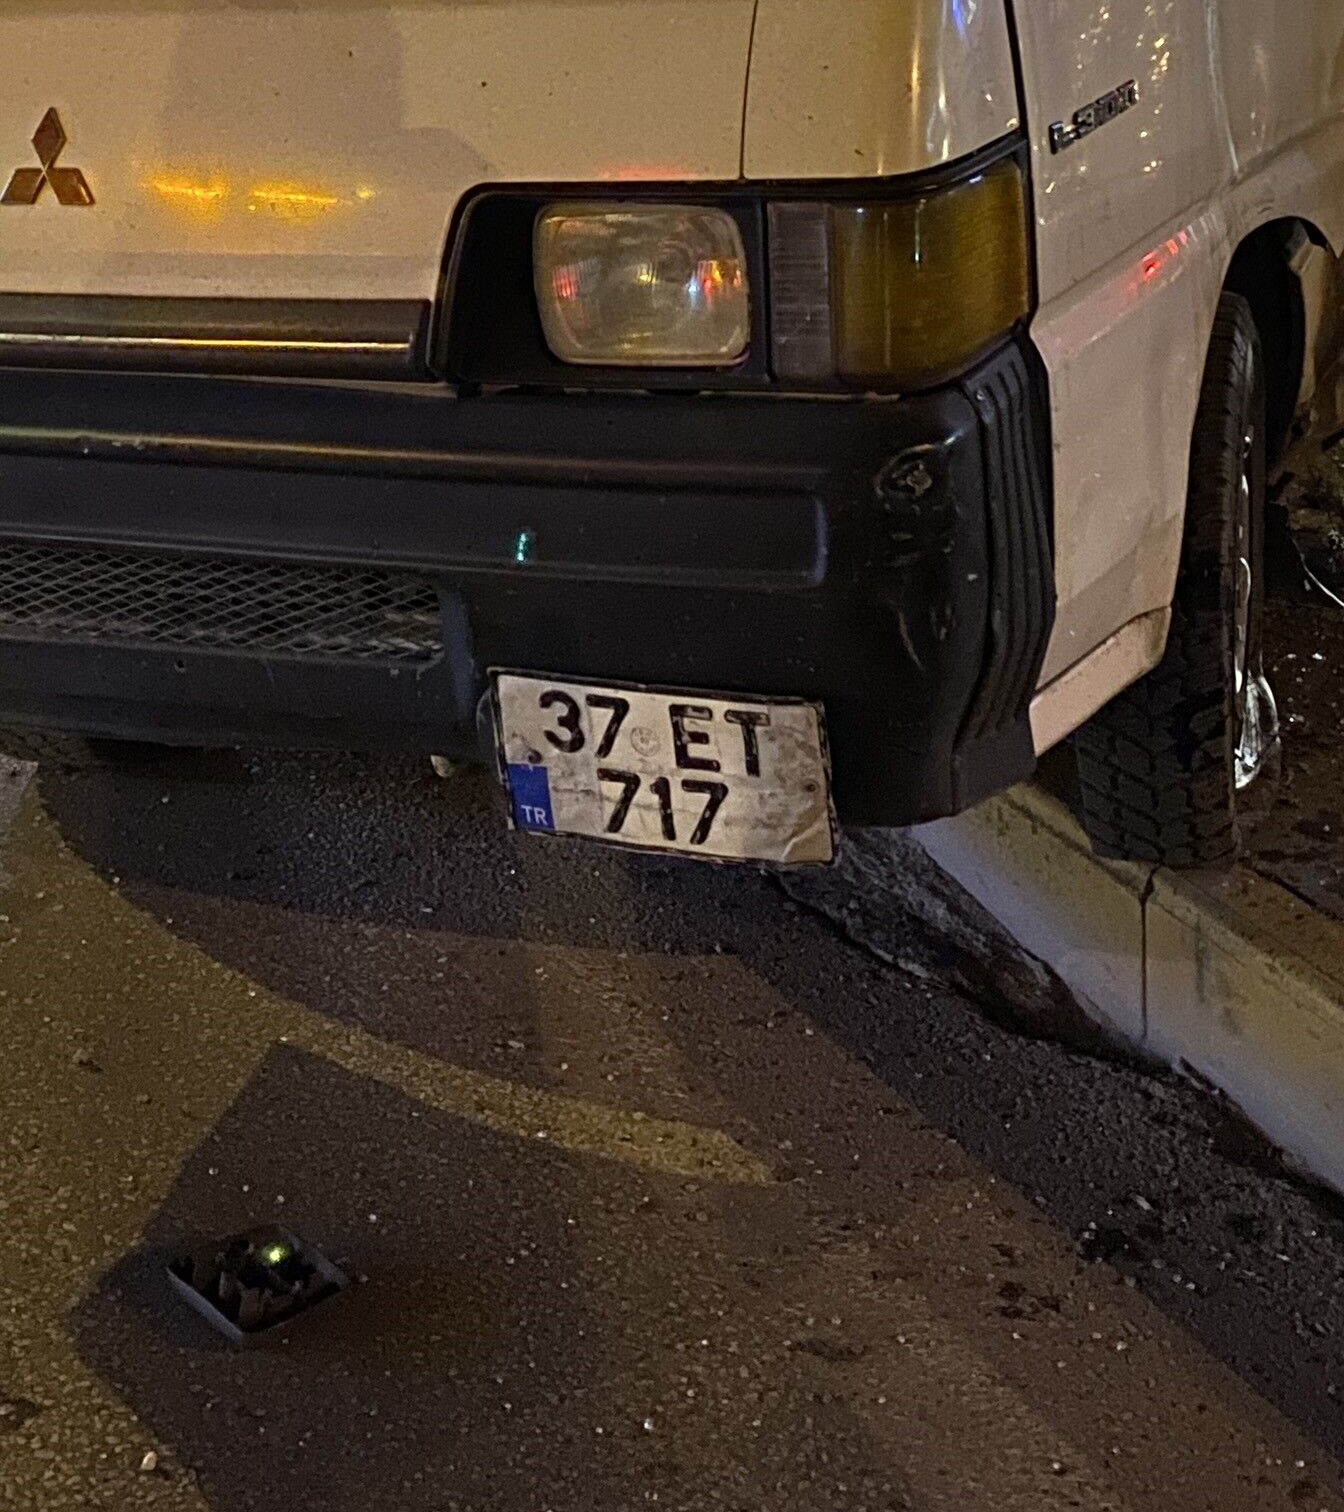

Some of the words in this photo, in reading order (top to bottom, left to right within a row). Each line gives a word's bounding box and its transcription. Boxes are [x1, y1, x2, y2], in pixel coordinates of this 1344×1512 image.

[538, 689, 631, 759] 37
[667, 702, 772, 778] ET
[521, 804, 548, 825] TR
[595, 766, 729, 846] 717
